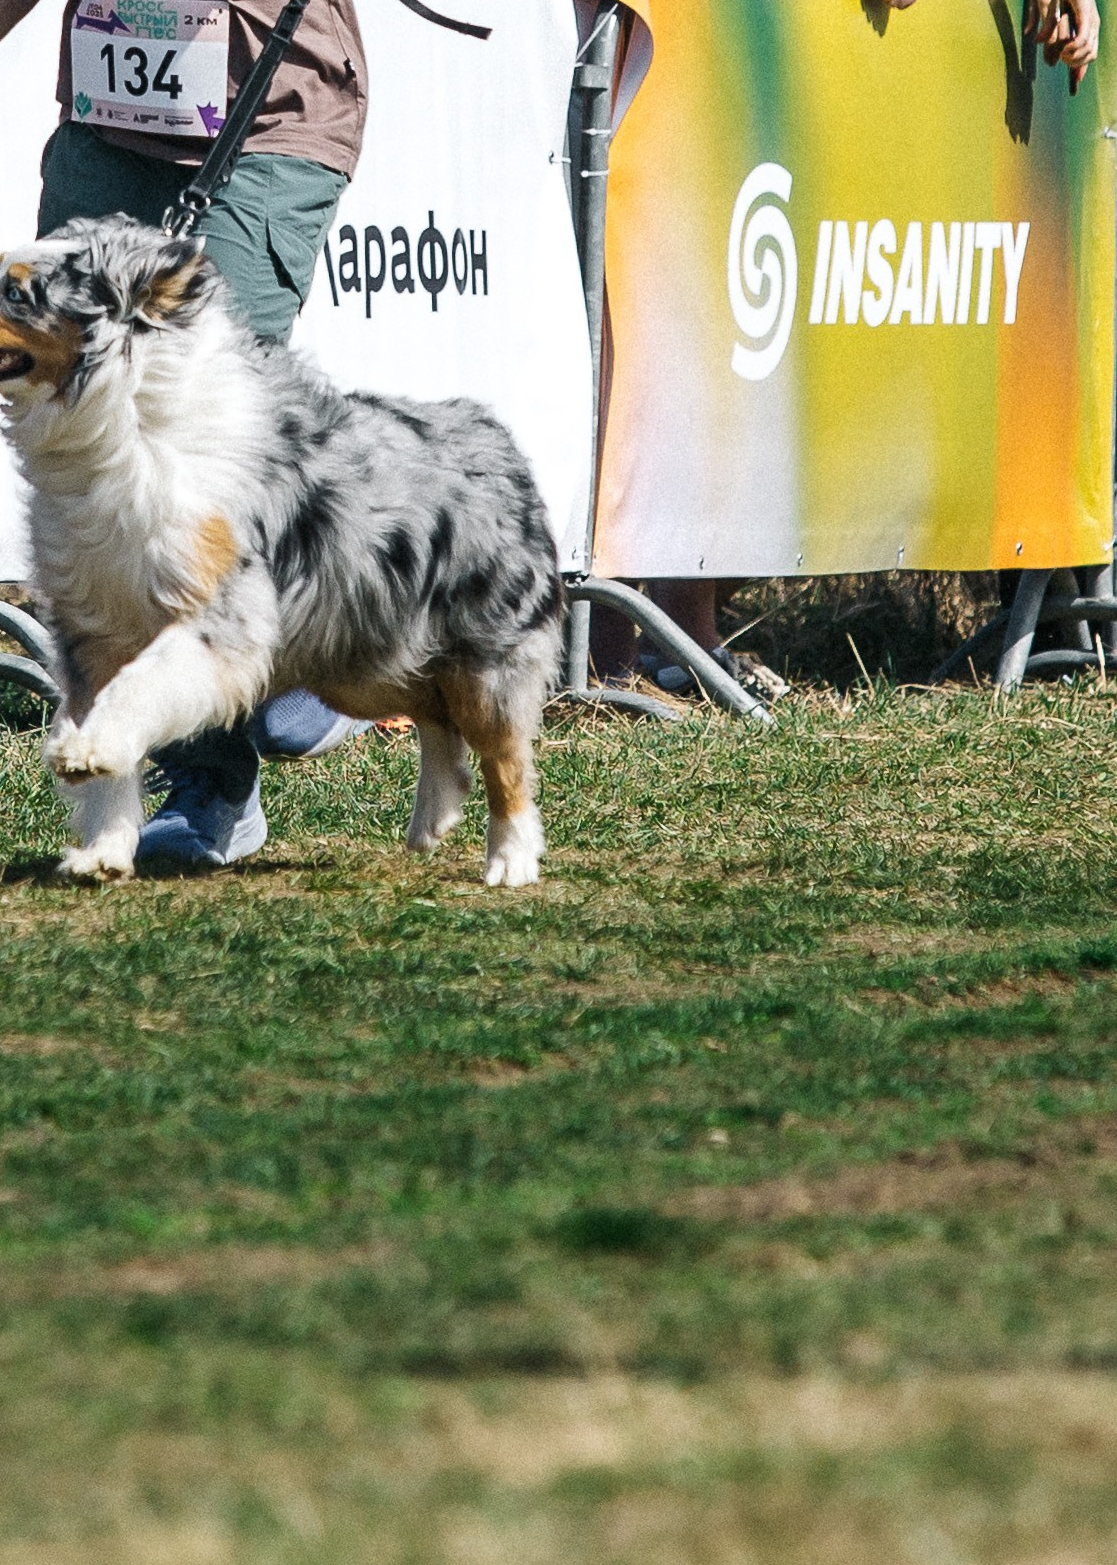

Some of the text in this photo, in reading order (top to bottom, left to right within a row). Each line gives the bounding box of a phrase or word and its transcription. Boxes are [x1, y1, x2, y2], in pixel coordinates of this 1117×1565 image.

[184, 15, 193, 25] 2
[100, 43, 183, 99] 134
[807, 218, 1031, 327] INSANITY
